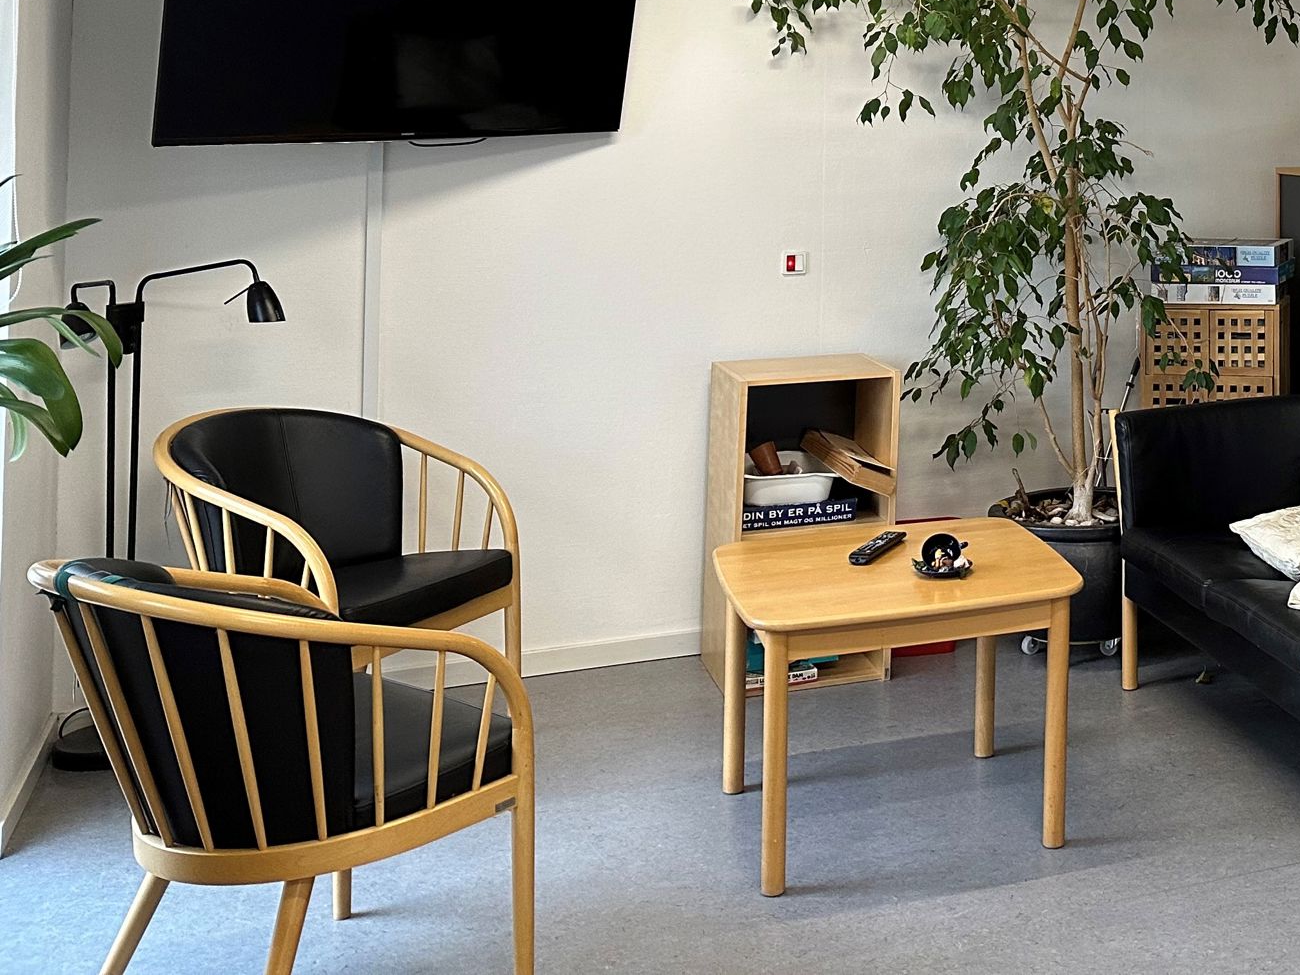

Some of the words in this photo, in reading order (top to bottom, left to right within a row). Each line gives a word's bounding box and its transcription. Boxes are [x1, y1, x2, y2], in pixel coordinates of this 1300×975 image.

[743, 512, 764, 521] DIN
[768, 509, 784, 519] BY
[788, 507, 804, 517] ER
[807, 503, 822, 515] PÅ
[826, 503, 852, 513] SPIL
[815, 513, 852, 522] MILLIONER
